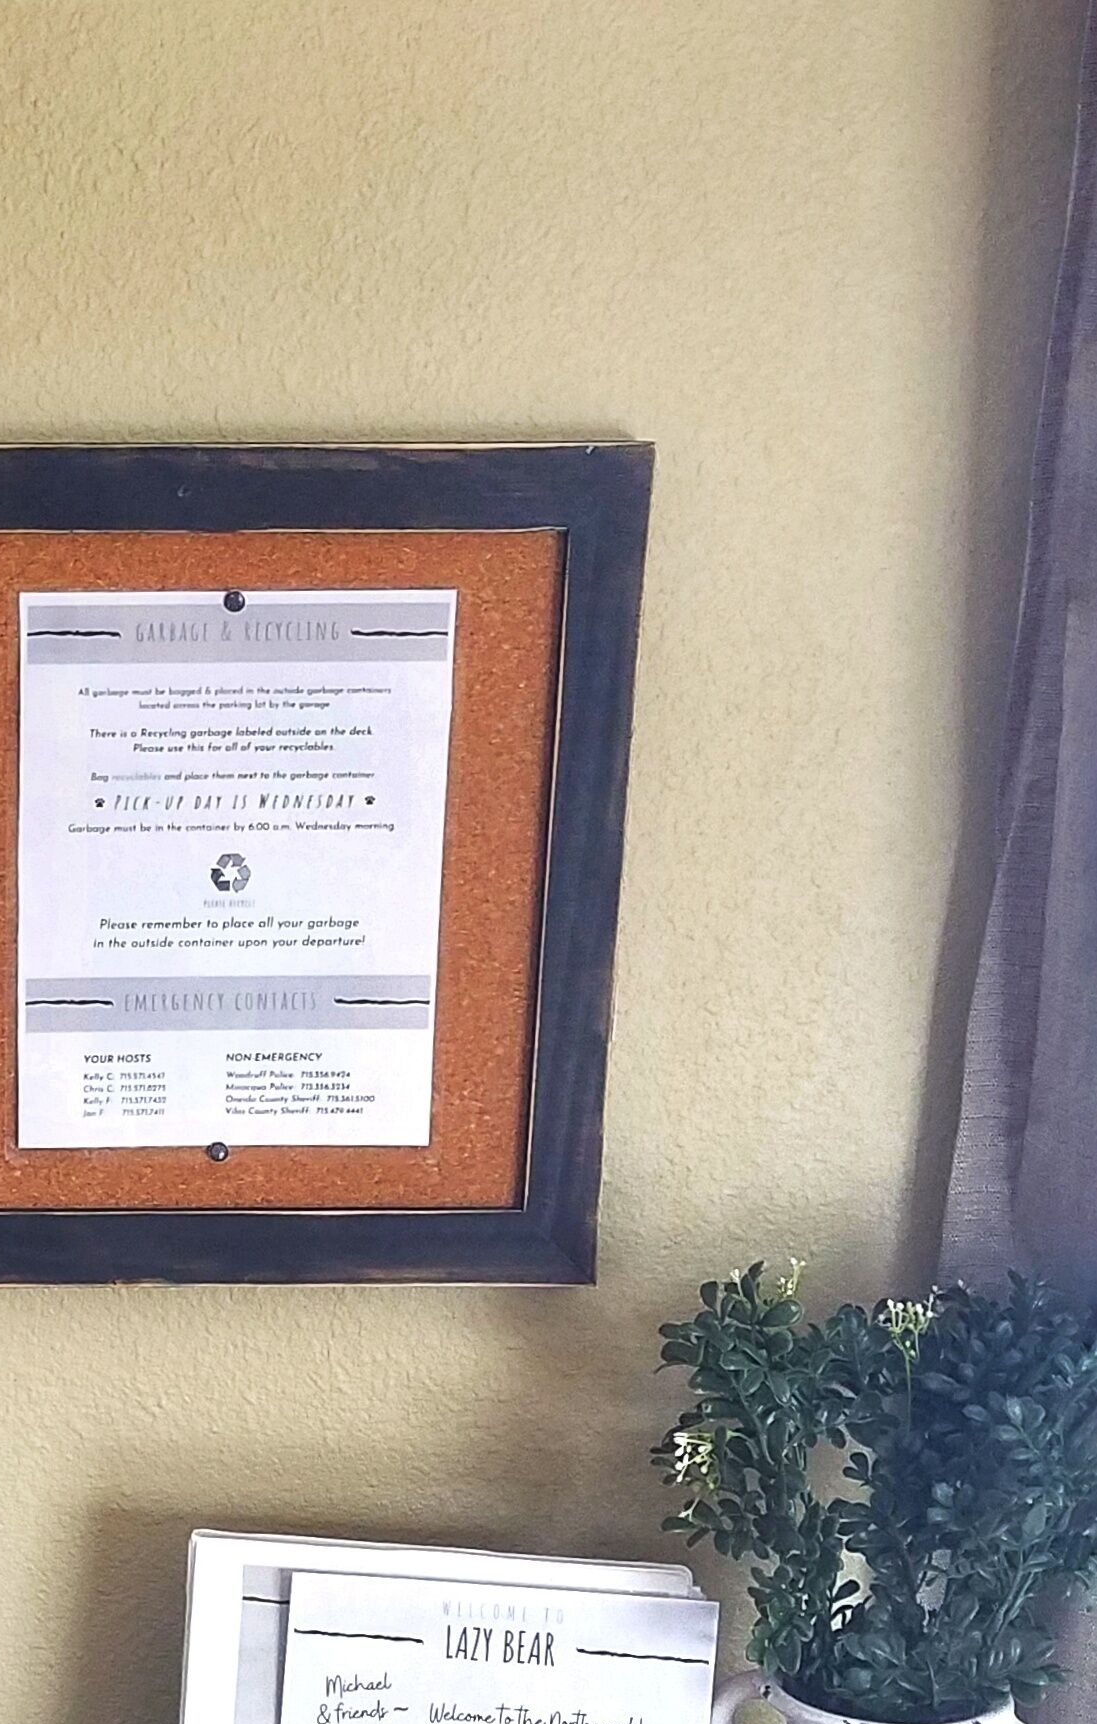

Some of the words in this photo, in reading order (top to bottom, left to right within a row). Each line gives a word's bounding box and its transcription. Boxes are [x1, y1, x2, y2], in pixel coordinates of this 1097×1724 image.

[136, 622, 208, 642] GARBAGE
[221, 621, 232, 641] &
[244, 621, 339, 641] RECYCLING
[90, 729, 116, 737] There
[141, 729, 186, 739] Recycling
[190, 728, 232, 738] garbage
[236, 727, 273, 736] labeled
[276, 727, 311, 736] outside
[331, 726, 346, 735] the
[133, 744, 164, 752] Please
[187, 743, 204, 752] this
[208, 743, 221, 751] for
[225, 742, 237, 751] all
[241, 742, 251, 751] of
[91, 773, 109, 782] Bag
[164, 772, 182, 780] and
[184, 772, 209, 781] place
[212, 771, 234, 779] them
[273, 771, 286, 779] the
[290, 771, 329, 781] garbage
[114, 795, 184, 810] PICK-UP
[194, 795, 222, 810] DAY
[232, 795, 247, 809] IS
[259, 793, 354, 809] WEDNESDAY
[68, 824, 110, 834] Garbage
[114, 824, 136, 832] must
[141, 823, 151, 831] be
[168, 823, 181, 831] the
[234, 822, 245, 832] by
[296, 822, 351, 831] Wednesday
[99, 918, 137, 930] Please
[142, 918, 202, 929] remember
[207, 919, 219, 929] to
[223, 917, 254, 931] place
[258, 917, 273, 928] all
[278, 920, 303, 930] your
[307, 917, 359, 929] garbage
[94, 938, 104, 948] in
[109, 938, 127, 948] the
[131, 937, 174, 948] outside
[178, 938, 234, 948] container
[238, 939, 268, 949] upon
[272, 939, 297, 948] your
[302, 935, 366, 948] departure!
[124, 993, 224, 1012] EMERGENCY
[235, 992, 316, 1011] CONTACTS
[84, 1055, 114, 1063] YOUR
[117, 1054, 151, 1063] HOSTS
[446, 1624, 493, 1662] LAZY
[504, 1630, 554, 1667] BEAR
[326, 1672, 392, 1698] Michael
[317, 1704, 334, 1724] &
[336, 1700, 388, 1721] friends
[429, 1703, 496, 1724] Welcome
[496, 1703, 513, 1724] to
